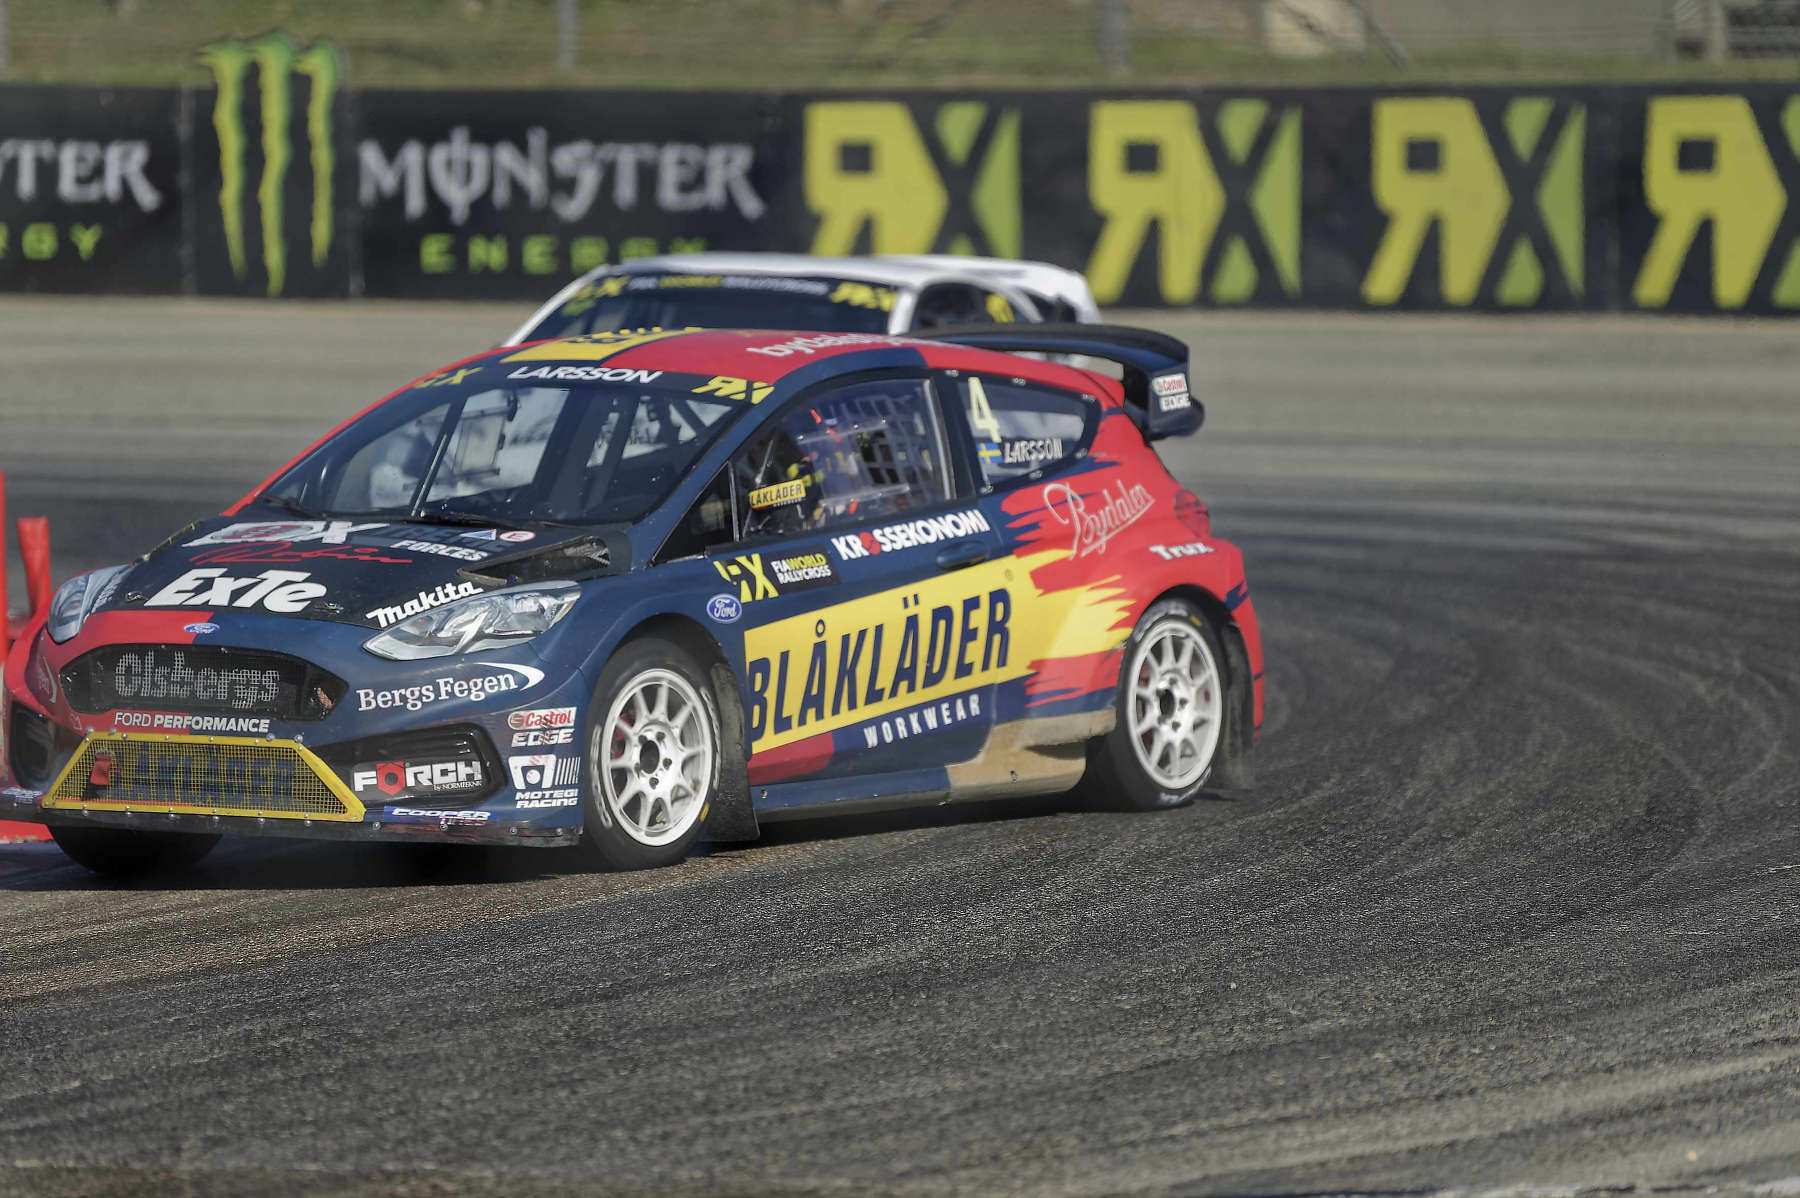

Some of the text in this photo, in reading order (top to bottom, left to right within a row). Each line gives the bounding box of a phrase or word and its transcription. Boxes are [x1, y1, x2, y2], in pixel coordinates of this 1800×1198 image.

[0, 137, 163, 213] TER
[358, 126, 766, 226] MONSTER
[1632, 95, 1800, 308] R
[0, 222, 103, 261] GY
[507, 366, 663, 384] LARSSON
[967, 376, 1002, 443] 4
[1160, 393, 1191, 411] EDGE
[1003, 438, 1063, 464] LARSSON
[390, 539, 489, 561] FORCES
[776, 564, 832, 584] RALLYCROSS
[711, 596, 739, 620] Ford
[748, 587, 1013, 742] BLÅKLÄDER
[356, 672, 519, 712] Bergs Fegen
[114, 711, 270, 734] FORD PERFORMANCE
[523, 709, 573, 728] Castrol
[863, 694, 981, 749] WORKWEAR
[511, 728, 575, 748] EDGE
[515, 788, 579, 801] MOTEGI
[515, 798, 578, 809] RACING
[392, 808, 491, 821] COOPER
